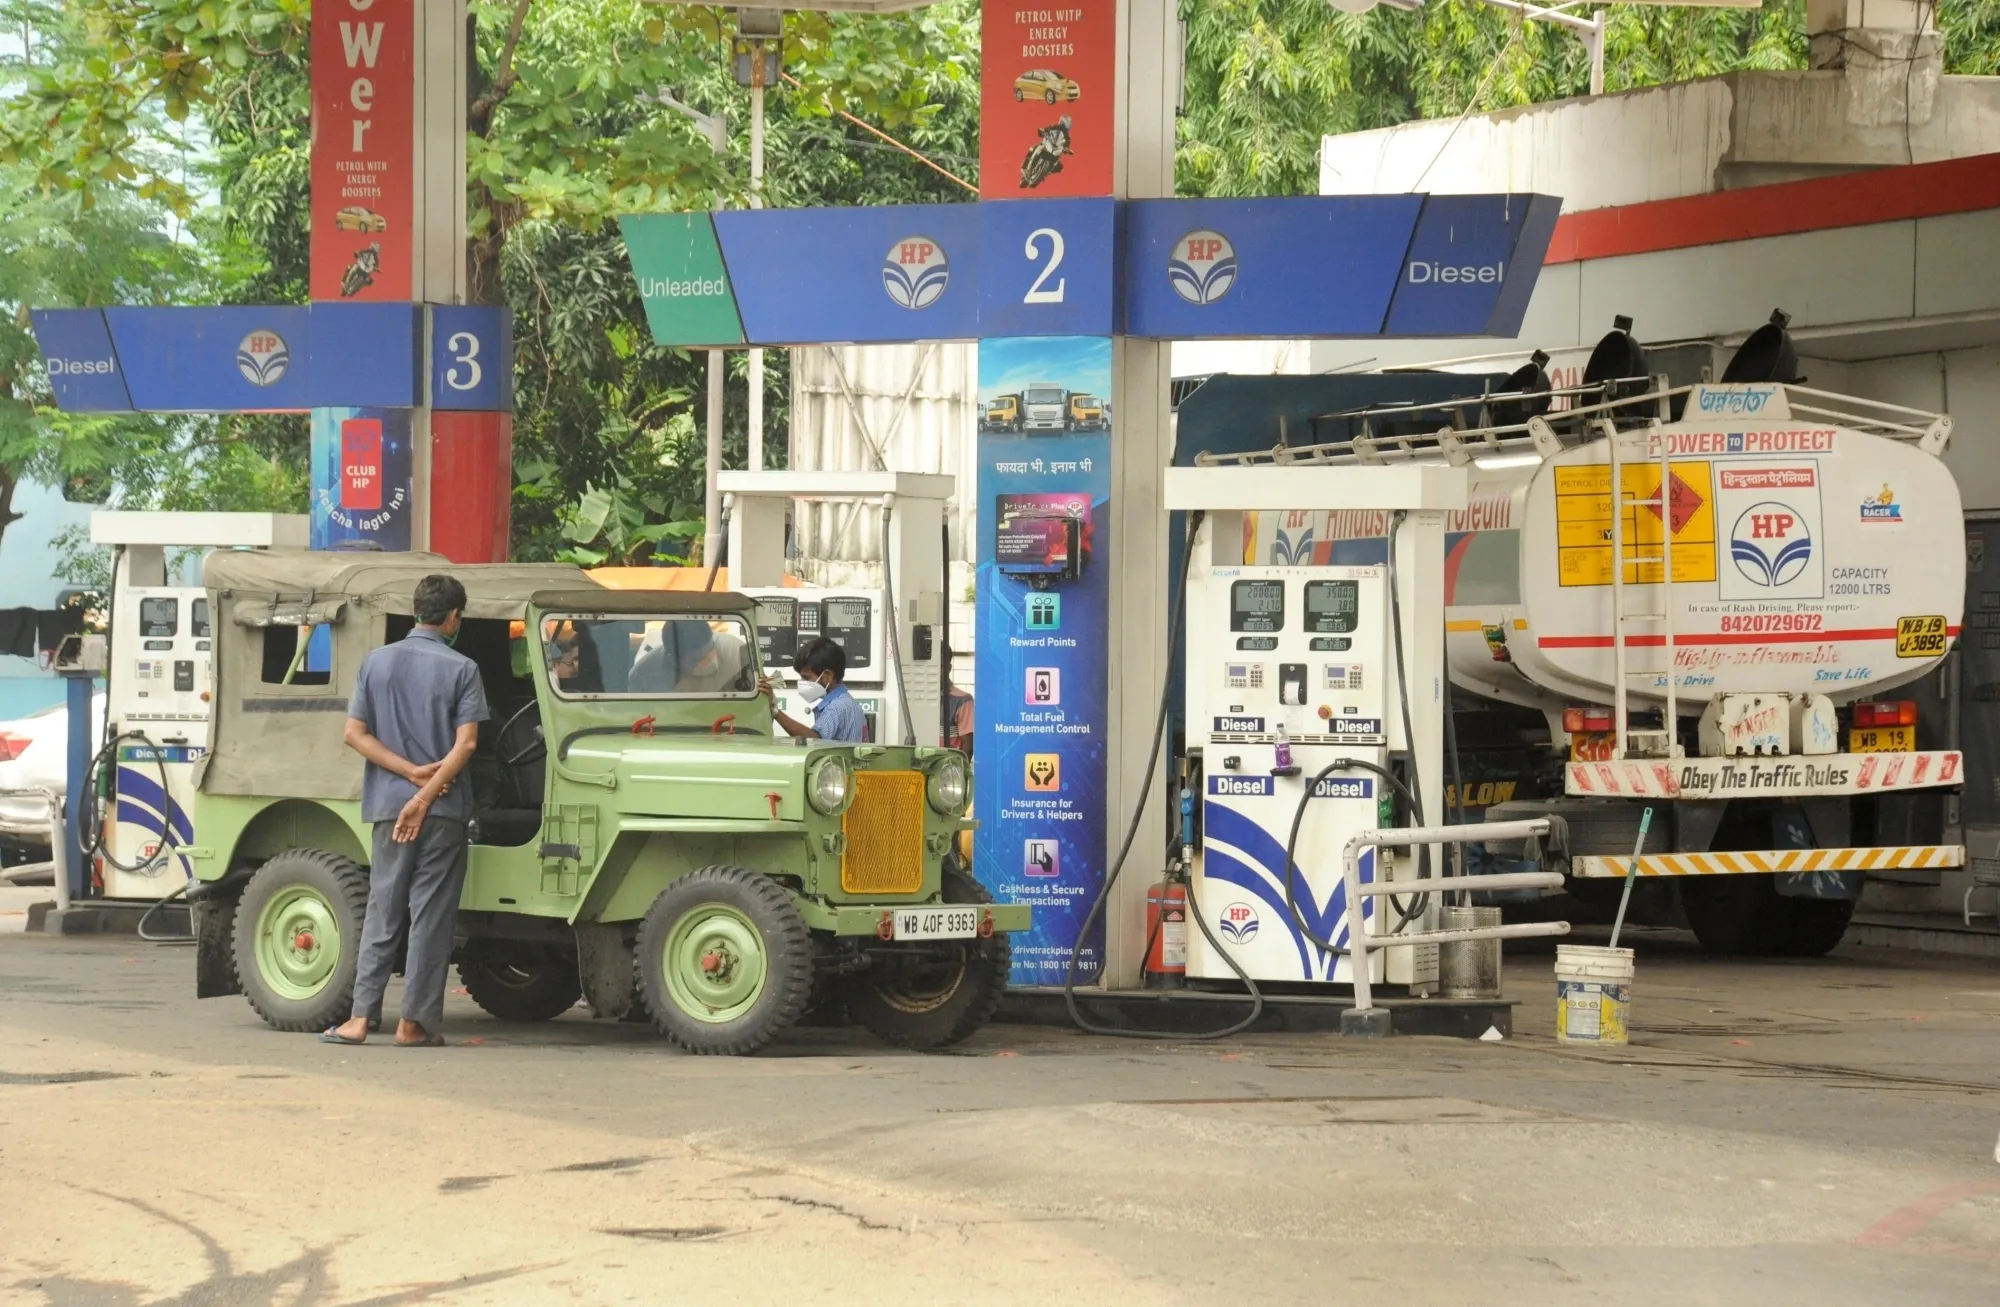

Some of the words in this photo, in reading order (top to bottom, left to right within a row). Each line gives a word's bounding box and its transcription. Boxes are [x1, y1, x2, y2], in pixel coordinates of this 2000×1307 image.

[1015, 11, 1052, 24] PETROL
[1055, 9, 1082, 22] WITH
[1029, 27, 1068, 40] ENERGY
[1022, 43, 1074, 57] BOOSTERS
[336, 161, 365, 171] PETROL
[367, 161, 387, 171] WITH
[347, 174, 376, 184] ENERGY
[899, 243, 933, 265] HP
[1187, 239, 1222, 261] HP
[1023, 227, 1065, 304] 2
[1409, 261, 1503, 284] Diesel
[641, 276, 724, 299] Unleaded
[251, 337, 277, 353] HP
[47, 357, 114, 375] Diesel
[446, 332, 482, 390] 3
[1650, 433, 1726, 455] POWER
[1729, 437, 1741, 447] TO
[1743, 430, 1837, 451] PROTECT
[346, 465, 376, 476] CLUB
[996, 461, 1028, 474] फायदा
[1051, 461, 1076, 475] इनाम
[1079, 458, 1092, 473] भी
[352, 478, 370, 488] HP
[359, 511, 391, 531] lagta
[389, 487, 405, 510] hai
[1863, 509, 1891, 517] RACER
[1672, 514, 1680, 527] 3
[1751, 514, 1794, 538] HP
[1832, 568, 1888, 579] CAPACITY
[1829, 584, 1860, 595] 12000
[1863, 584, 1891, 595] LTRS
[1688, 604, 1698, 612] In
[1700, 605, 1720, 613] case
[1721, 604, 1730, 612] of
[1733, 604, 1755, 612] Rash
[1797, 603, 1824, 612] Please
[1721, 614, 1822, 632] 8420729672
[1010, 637, 1045, 647] Reward
[1047, 637, 1076, 647] Points
[1683, 674, 1715, 686] Drive
[1814, 669, 1842, 681] Save
[1845, 667, 1872, 680] Life
[1020, 712, 1043, 722] Total
[1045, 712, 1065, 722] Fuel
[995, 724, 1054, 735] Management
[1056, 724, 1090, 734] Control
[1221, 719, 1259, 731] Diesel
[1336, 720, 1375, 733] Diesel
[1861, 732, 1877, 747] WB
[1680, 766, 1719, 793] Obey
[1720, 765, 1747, 789] The
[1750, 764, 1802, 788] Traffic
[1805, 764, 1849, 787] Rules
[1217, 778, 1266, 794] Diesel
[1315, 780, 1364, 796] Diesel
[1011, 798, 1057, 808] Insurance
[1059, 798, 1073, 808] for
[1001, 809, 1035, 819] Drivers
[1037, 810, 1044, 819] &
[1046, 810, 1083, 821] Helpers
[999, 884, 1041, 894] Cashless
[1043, 884, 1050, 894] &
[1052, 885, 1085, 895] Secure
[1011, 895, 1070, 906] Transactions
[1230, 908, 1250, 920] HP
[904, 915, 918, 934] WB
[922, 914, 943, 933] 40F
[948, 913, 975, 932] 9363
[1023, 960, 1037, 969] No:
[1039, 961, 1059, 969] 1800
[1061, 961, 1071, 969] 10
[1078, 961, 1098, 970] 9811
